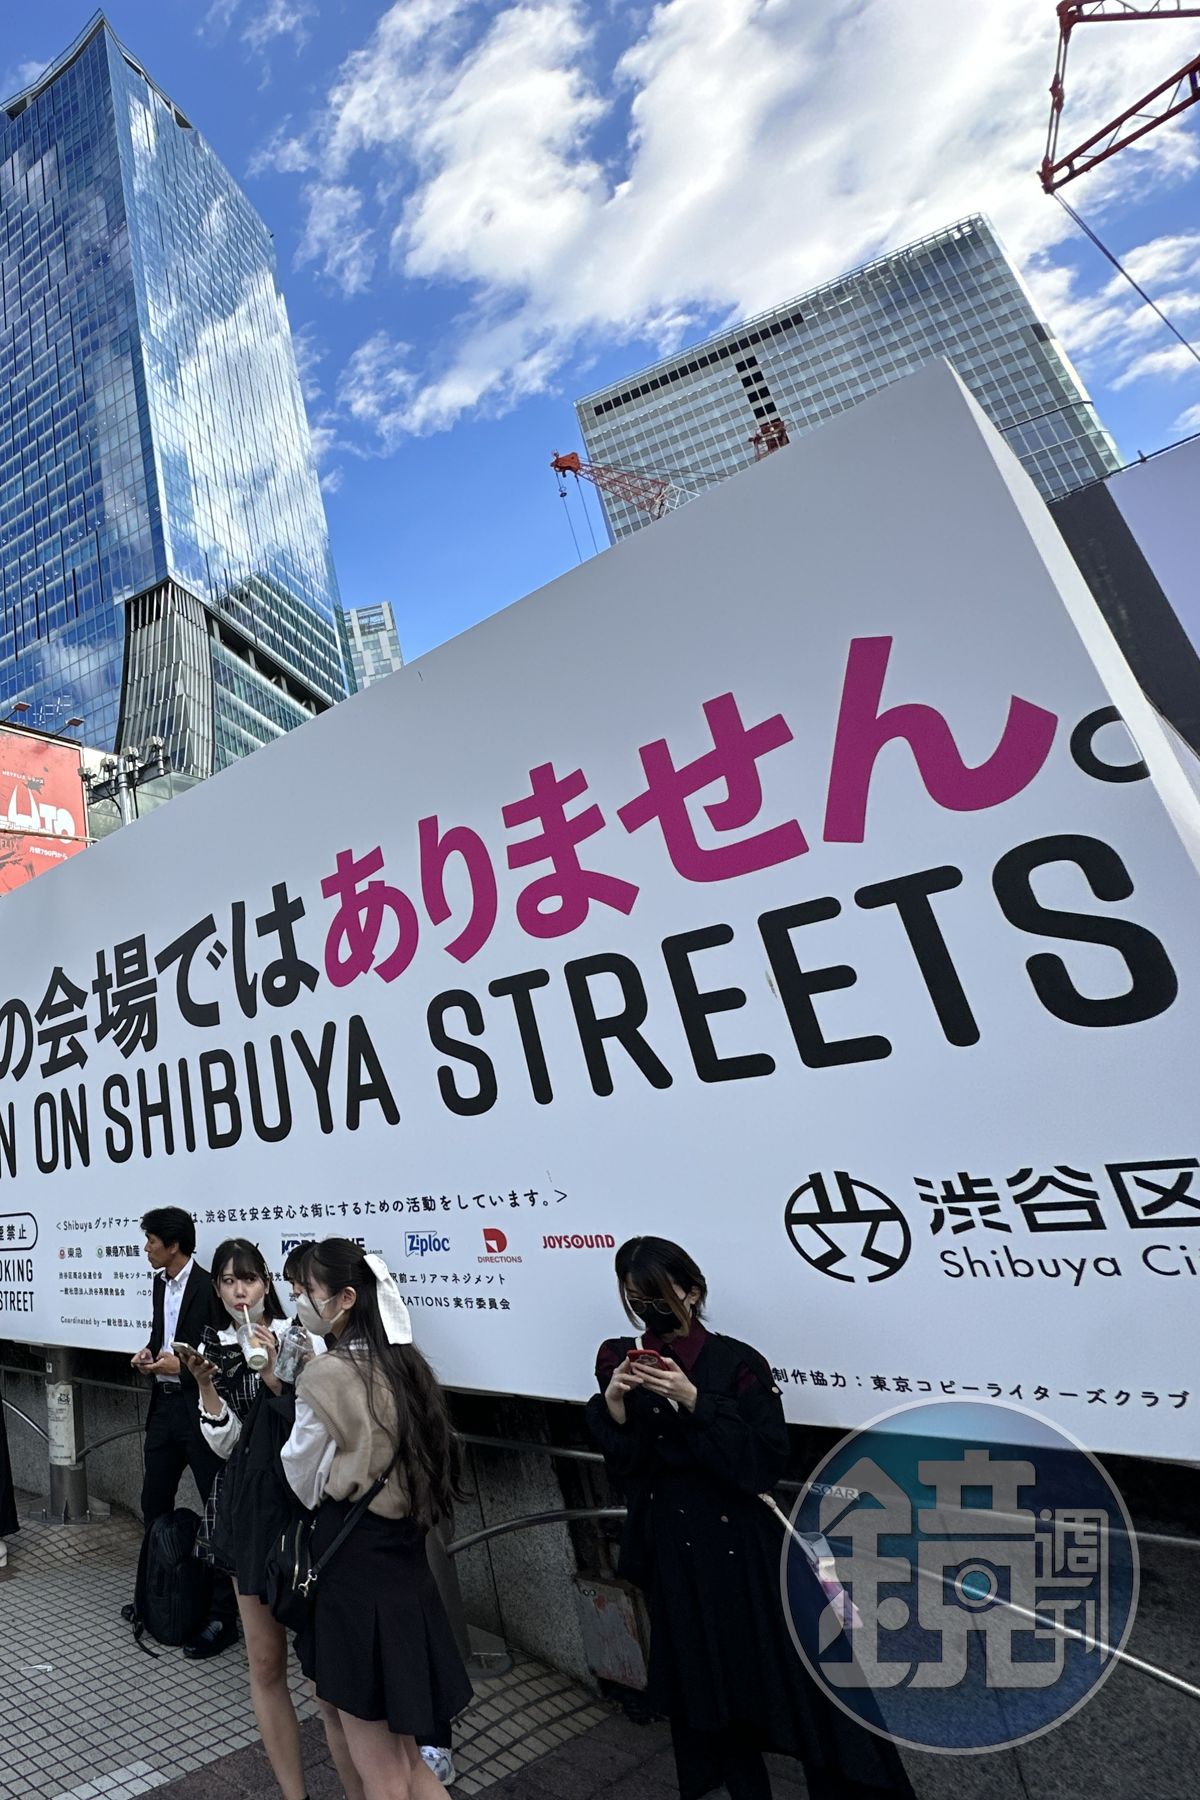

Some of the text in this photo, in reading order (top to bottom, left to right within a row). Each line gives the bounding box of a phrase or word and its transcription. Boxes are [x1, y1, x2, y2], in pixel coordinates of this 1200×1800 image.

[34, 1083, 91, 1174] ON
[102, 1014, 400, 1164] SHIBUYA
[425, 833, 1179, 1117] STREETS
[912, 1157, 1200, 1236] 渋谷区
[94, 1216, 143, 1230] グッドマナー
[406, 1234, 450, 1258] Ziploc
[542, 1234, 616, 1249] JOYSOUND
[67, 1247, 83, 1259] 東急
[105, 1244, 141, 1258] 東急不動産
[477, 1255, 523, 1264] DIRECTIONS
[939, 1244, 1200, 1287] Shibuya Ci
[452, 1297, 511, 1311] 実行委員会
